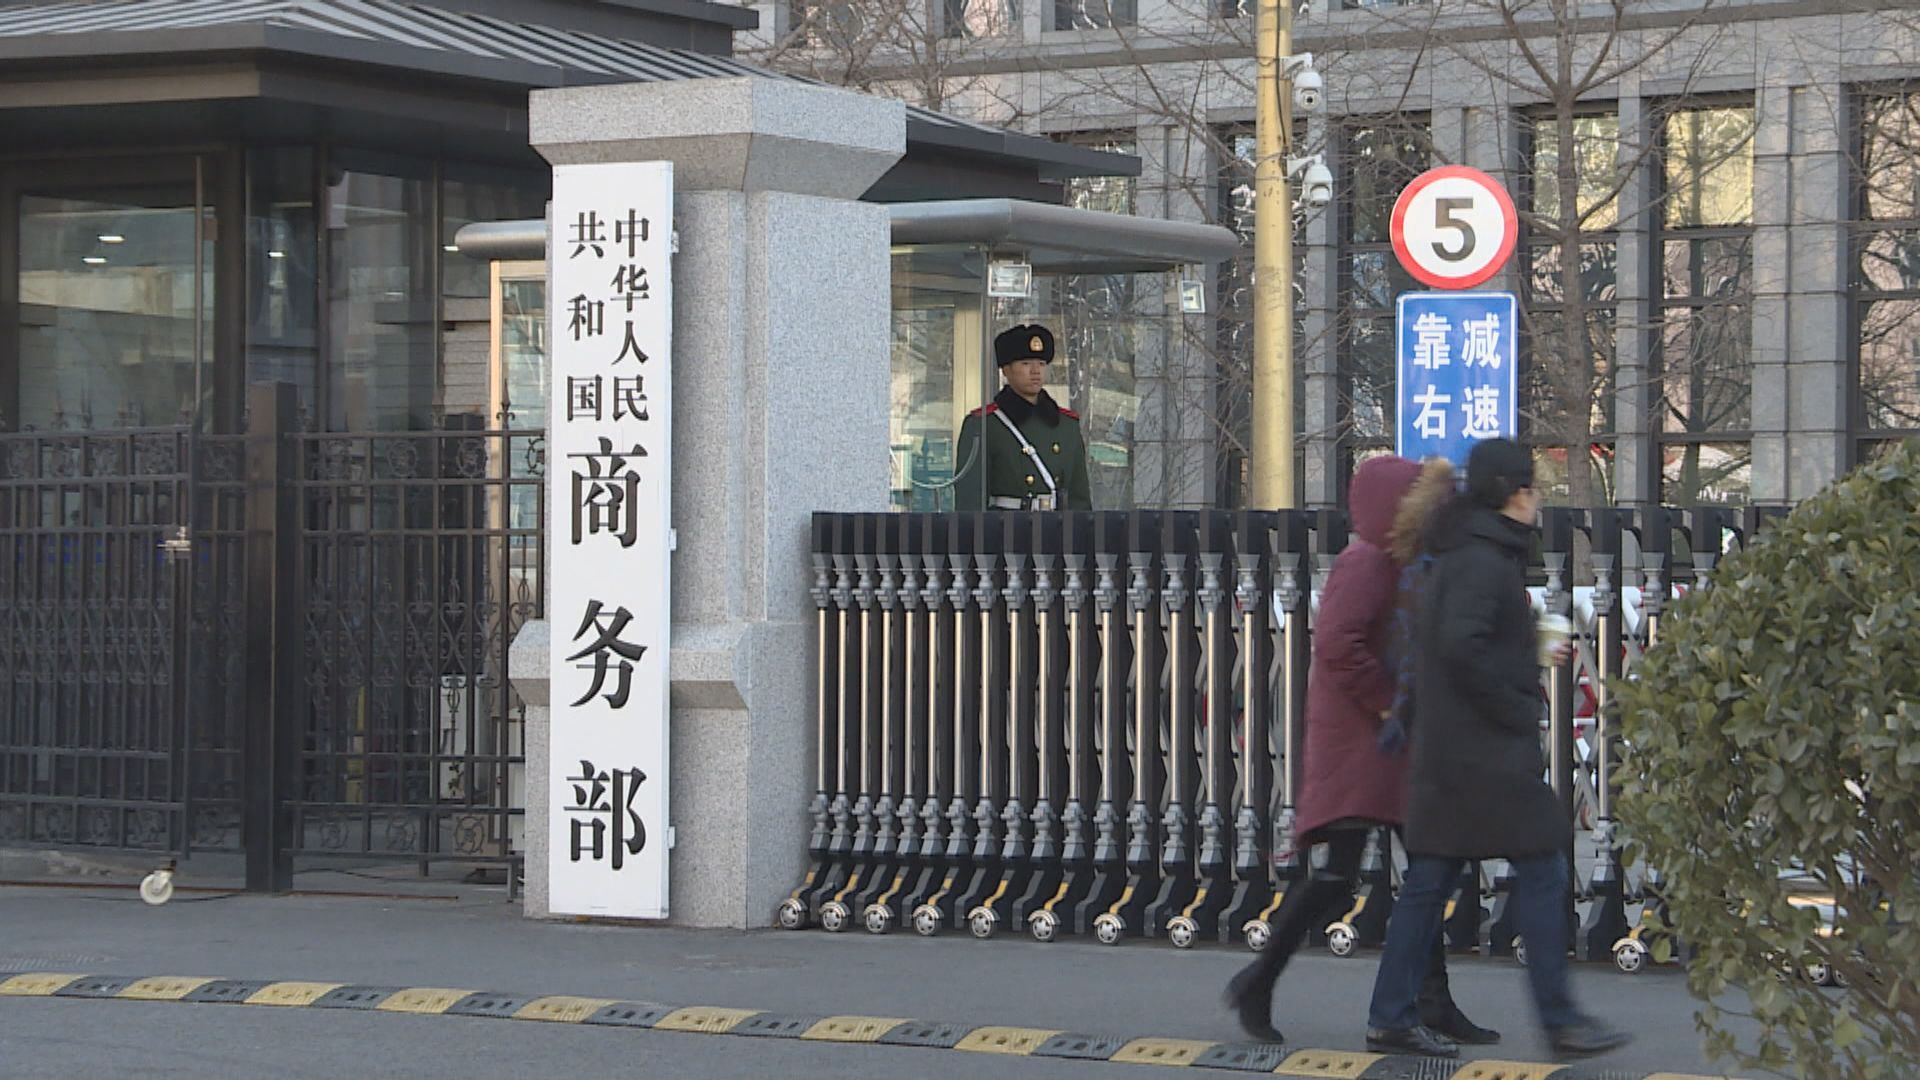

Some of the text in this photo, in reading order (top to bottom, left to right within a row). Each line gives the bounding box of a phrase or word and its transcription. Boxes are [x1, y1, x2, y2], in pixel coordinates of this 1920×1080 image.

[566, 211, 607, 423] 共和国
[609, 208, 650, 423] 中华人民
[1432, 197, 1476, 262] 5
[1412, 312, 1452, 462] 靠右
[564, 436, 648, 871] 商务部
